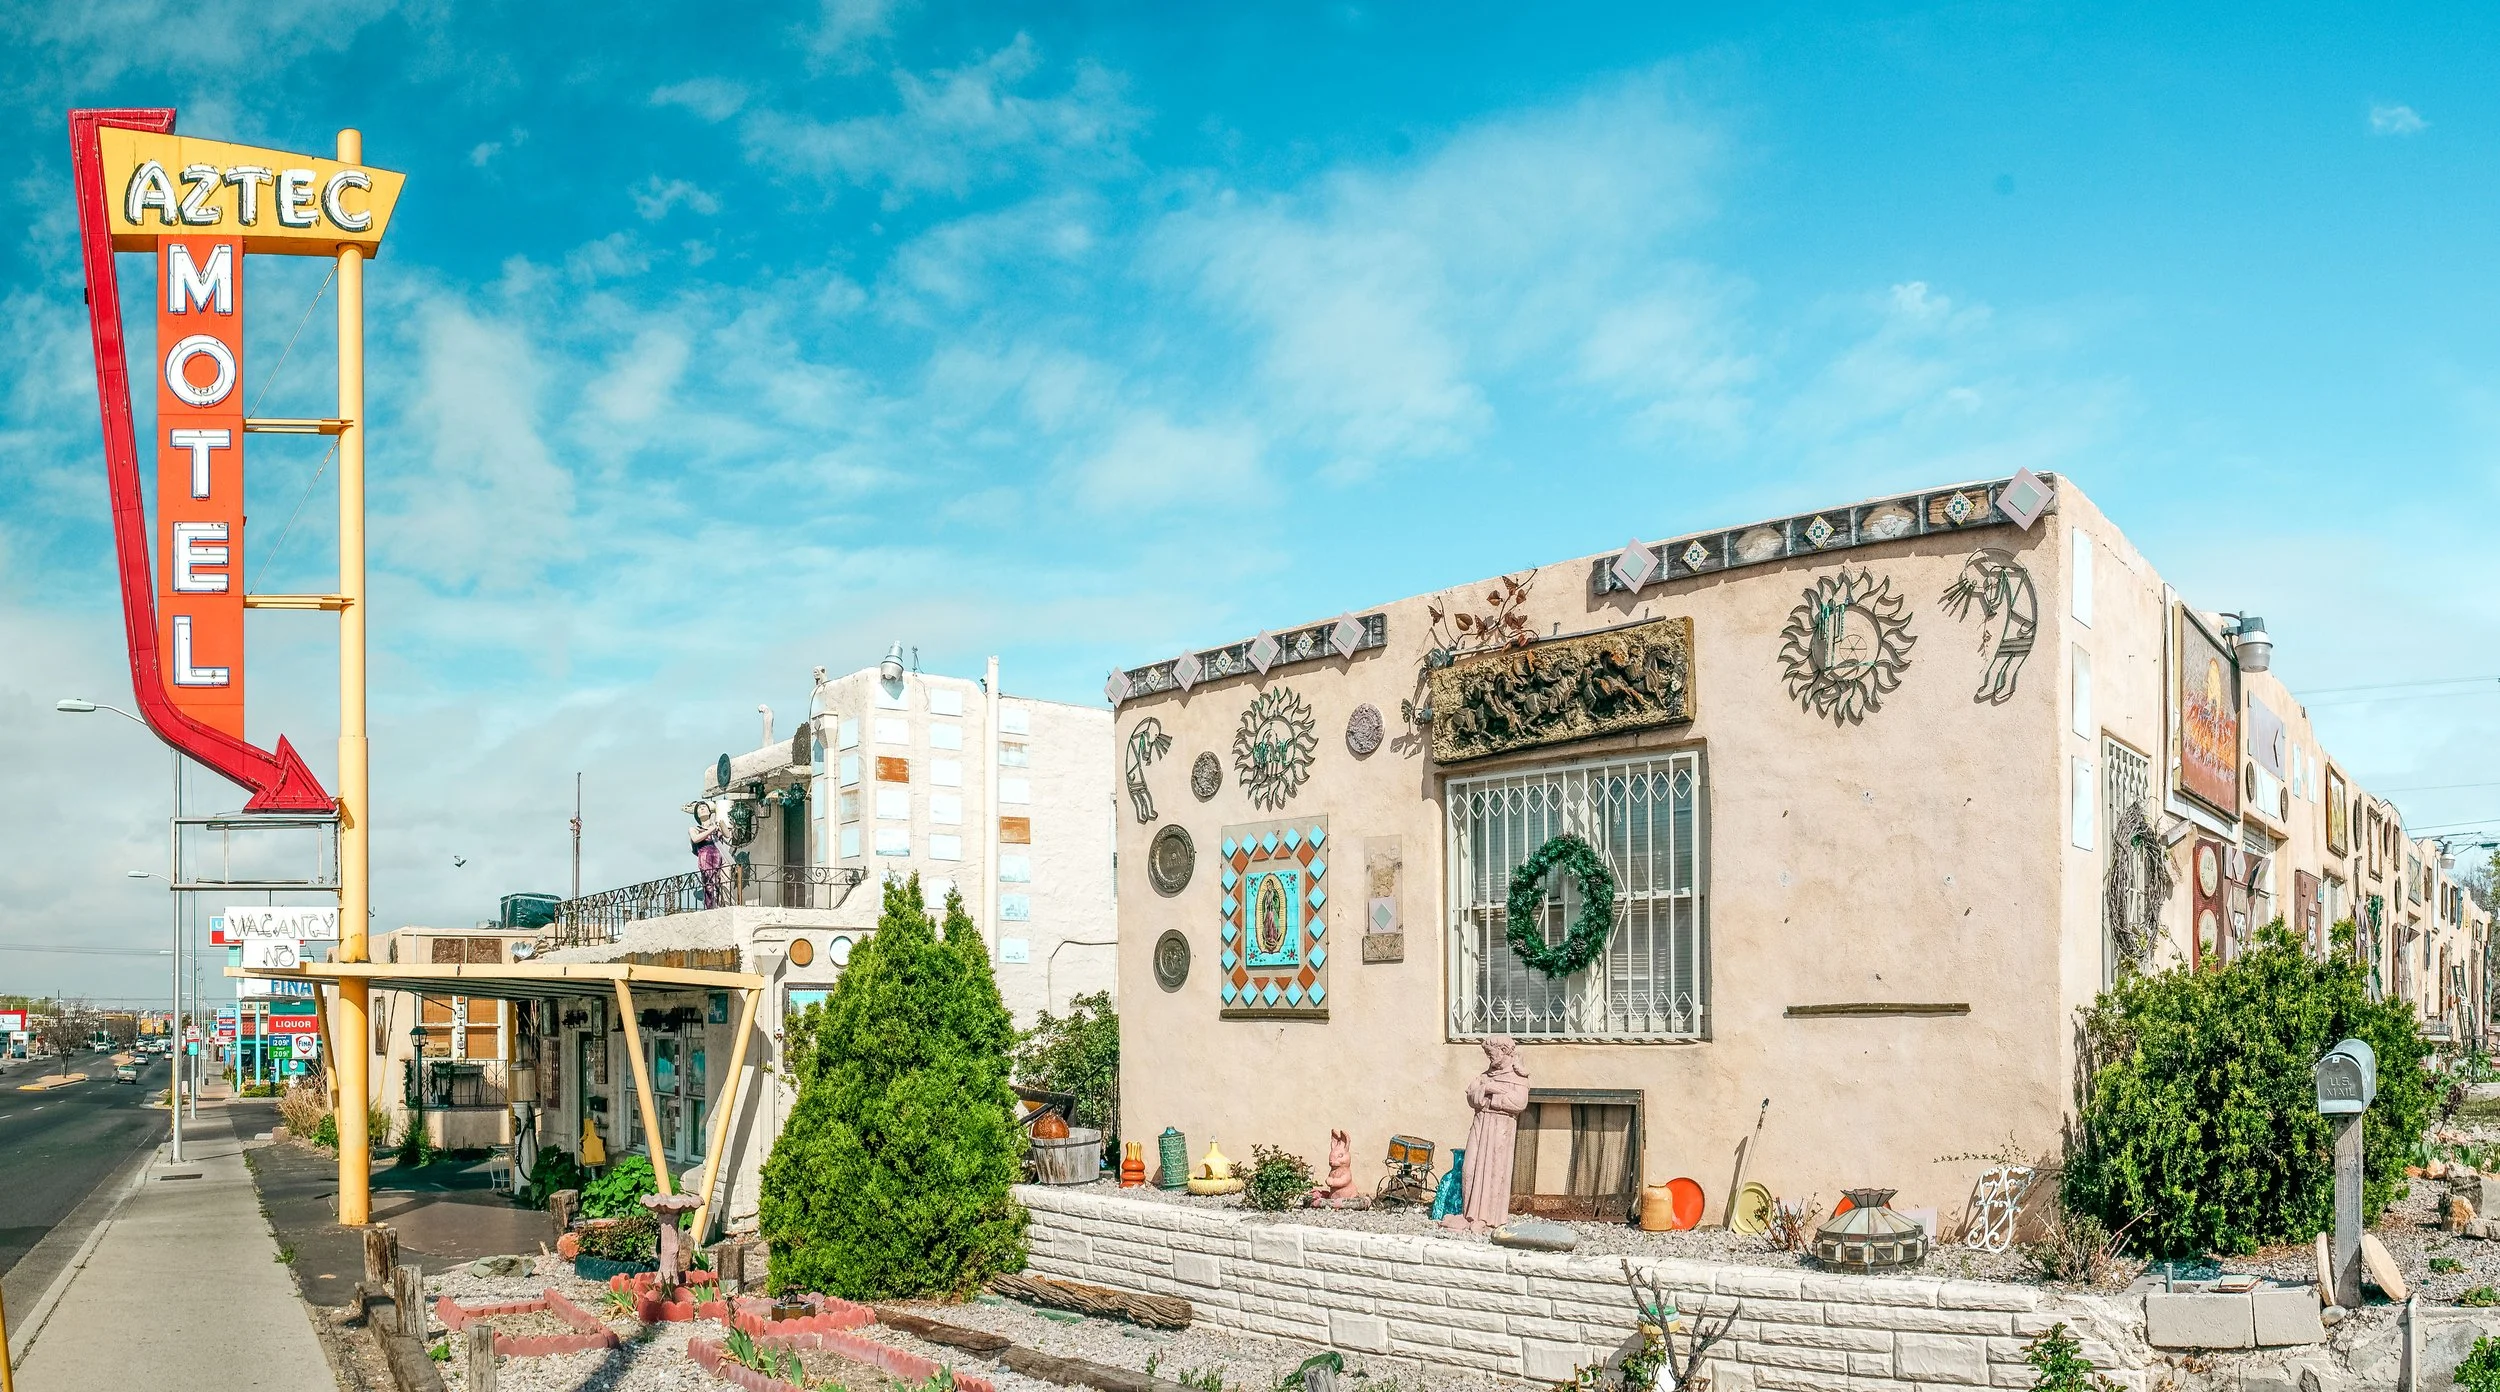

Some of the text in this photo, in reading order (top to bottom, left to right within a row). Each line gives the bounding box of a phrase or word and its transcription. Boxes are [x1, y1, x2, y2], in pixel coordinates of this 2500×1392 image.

[124, 158, 373, 232] AZTEC
[164, 243, 237, 687] MOTEL
[228, 913, 335, 939] VACANCY
[262, 945, 296, 967] NO
[271, 979, 313, 995] FINA
[2326, 1087, 2356, 1097] MAIL
